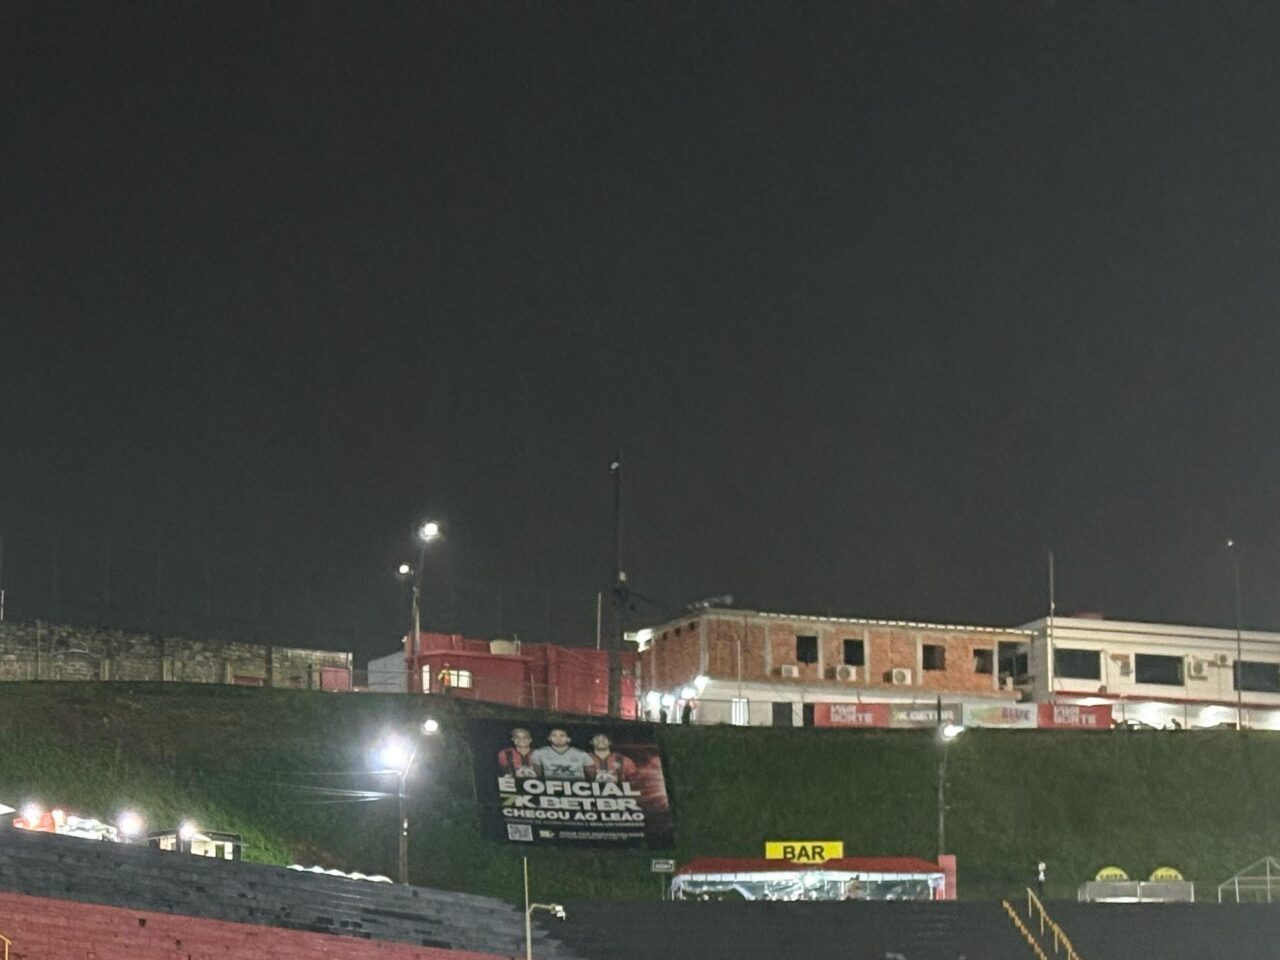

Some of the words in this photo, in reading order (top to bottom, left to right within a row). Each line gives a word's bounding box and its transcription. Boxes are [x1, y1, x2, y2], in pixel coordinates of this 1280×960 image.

[498, 774, 517, 793] É
[523, 779, 641, 797] OFICIAL
[502, 808, 570, 820] CHEGOU
[574, 811, 598, 821] AO
[601, 810, 645, 821] LEÃO
[783, 845, 825, 861] BAR
